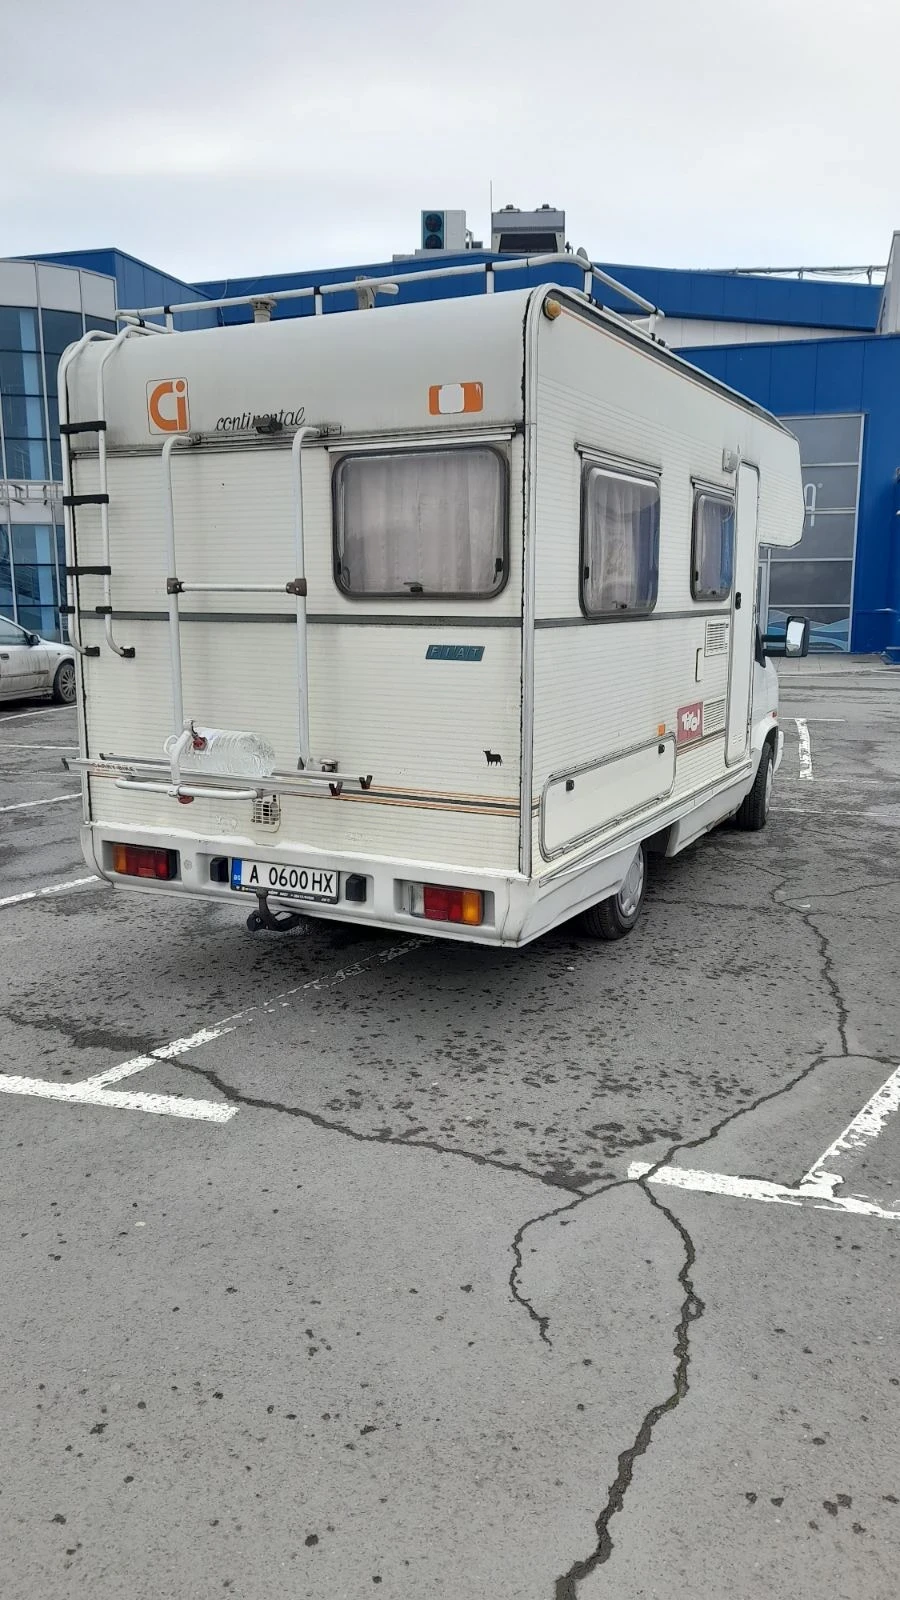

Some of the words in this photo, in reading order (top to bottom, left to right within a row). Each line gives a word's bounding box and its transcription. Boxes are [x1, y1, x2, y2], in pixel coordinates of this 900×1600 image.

[430, 646, 480, 657] FIAT
[249, 864, 259, 884] A
[268, 866, 309, 889] 0600
